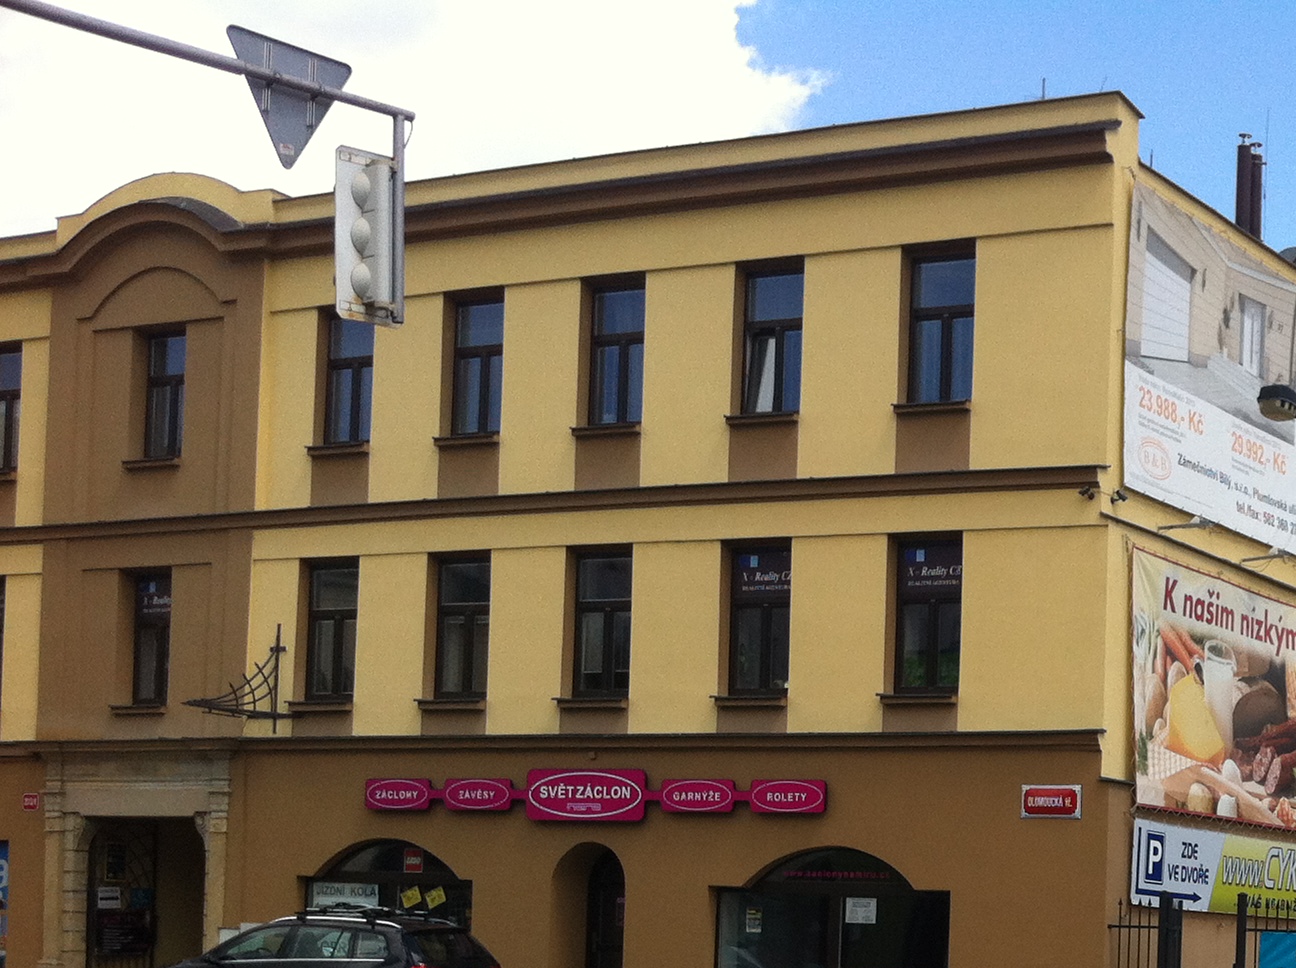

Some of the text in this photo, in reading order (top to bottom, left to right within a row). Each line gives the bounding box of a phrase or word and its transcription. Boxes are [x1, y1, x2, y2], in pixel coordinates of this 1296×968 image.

[1188, 409, 1205, 435] Kč
[1273, 451, 1287, 475] Kč
[755, 571, 780, 583] Reality
[921, 565, 949, 578] Reality
[1163, 576, 1178, 613] K
[1183, 588, 1235, 632] našim
[375, 789, 418, 799] ZÁCLONY
[458, 789, 495, 800] ZÁVĚSY
[539, 783, 631, 800] SVĚT ZÁCLON
[673, 790, 721, 801] GARNÝŽE
[767, 792, 807, 802] ROLETY
[1147, 839, 1198, 875] P ZDE
[1168, 863, 1209, 885] VE DVOŘE
[316, 883, 377, 897] JÍZDNÍ KOLA
